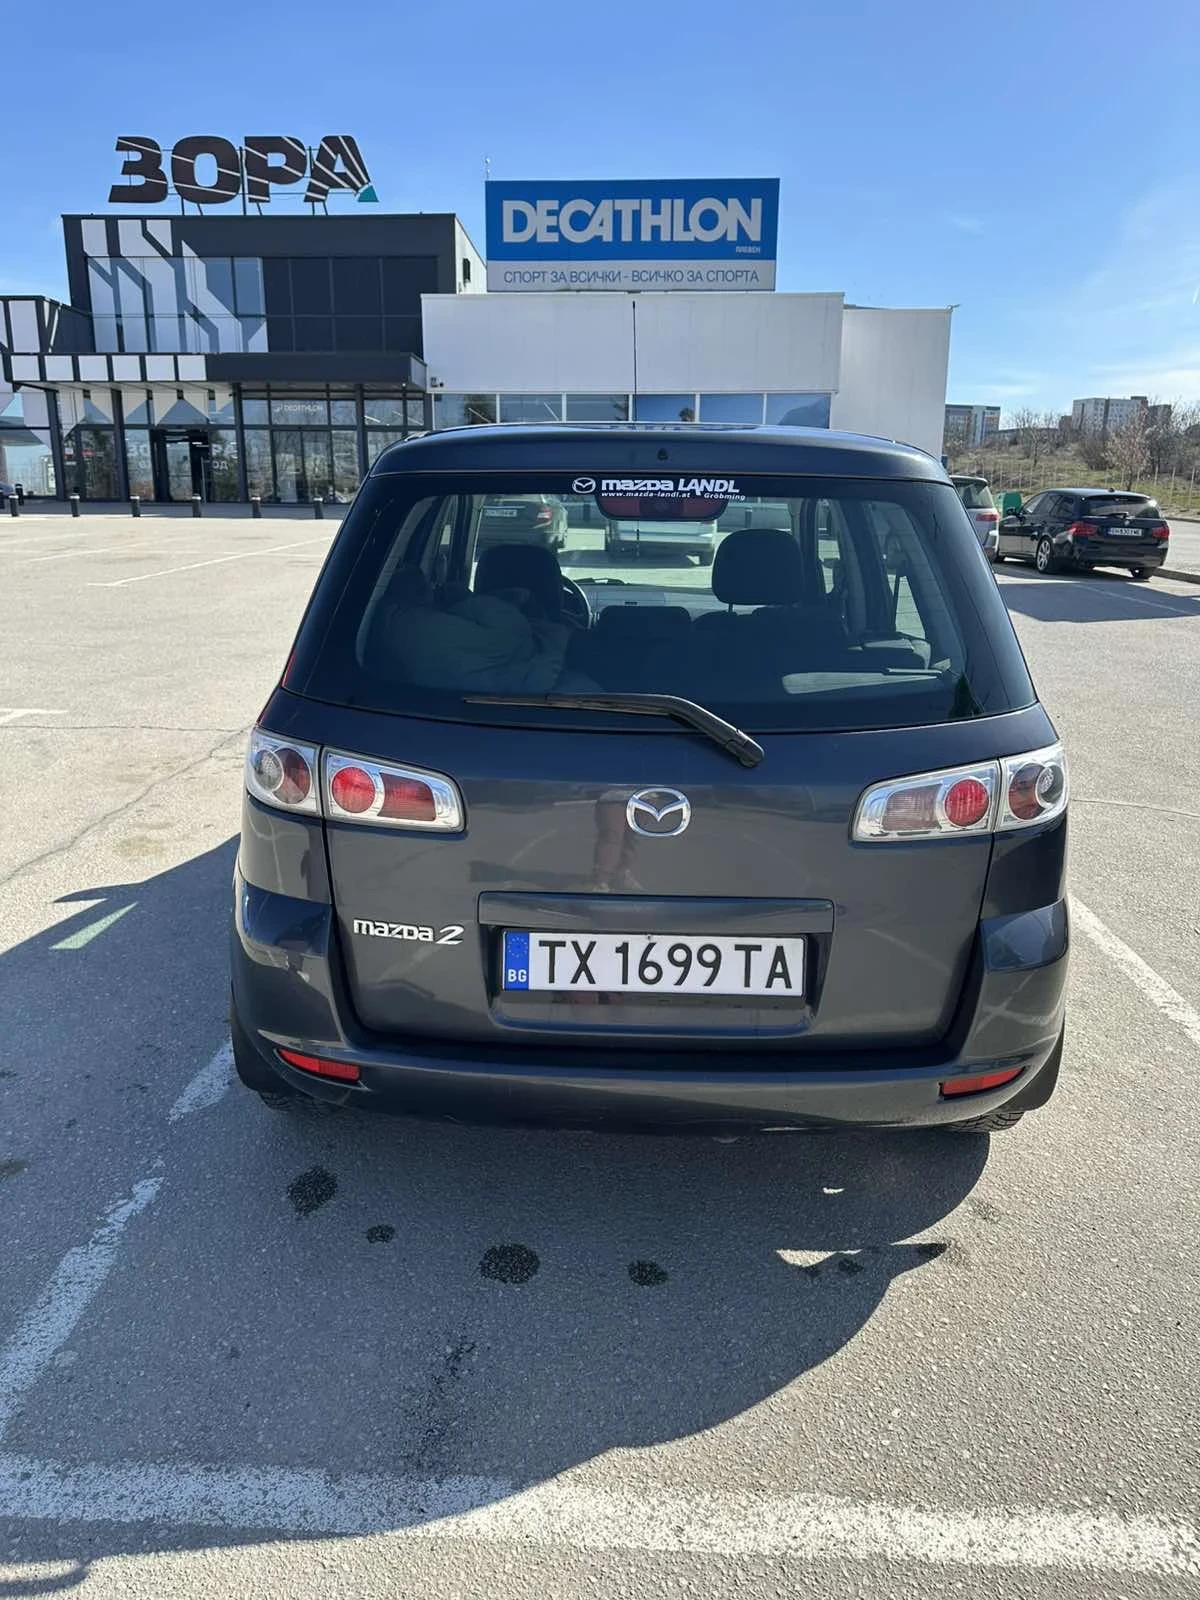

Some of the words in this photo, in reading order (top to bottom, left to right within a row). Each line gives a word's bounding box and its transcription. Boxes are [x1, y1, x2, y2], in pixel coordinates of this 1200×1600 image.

[108, 135, 379, 204] ЗОРА
[502, 198, 762, 243] DECATHLON
[504, 271, 547, 284] СПОРТ
[551, 271, 567, 283] ЗА
[570, 271, 621, 283] ВСИЧКИ
[632, 270, 684, 282] ВСИЧКО
[687, 270, 703, 282] ЗА
[706, 270, 759, 282] СПОРТА
[678, 478, 740, 496] LANDL
[703, 492, 746, 501] Gröbming
[435, 925, 465, 945] 2
[538, 940, 597, 985] TX
[614, 942, 723, 987] 1699
[734, 945, 793, 989] TA
[507, 968, 527, 983] BG
